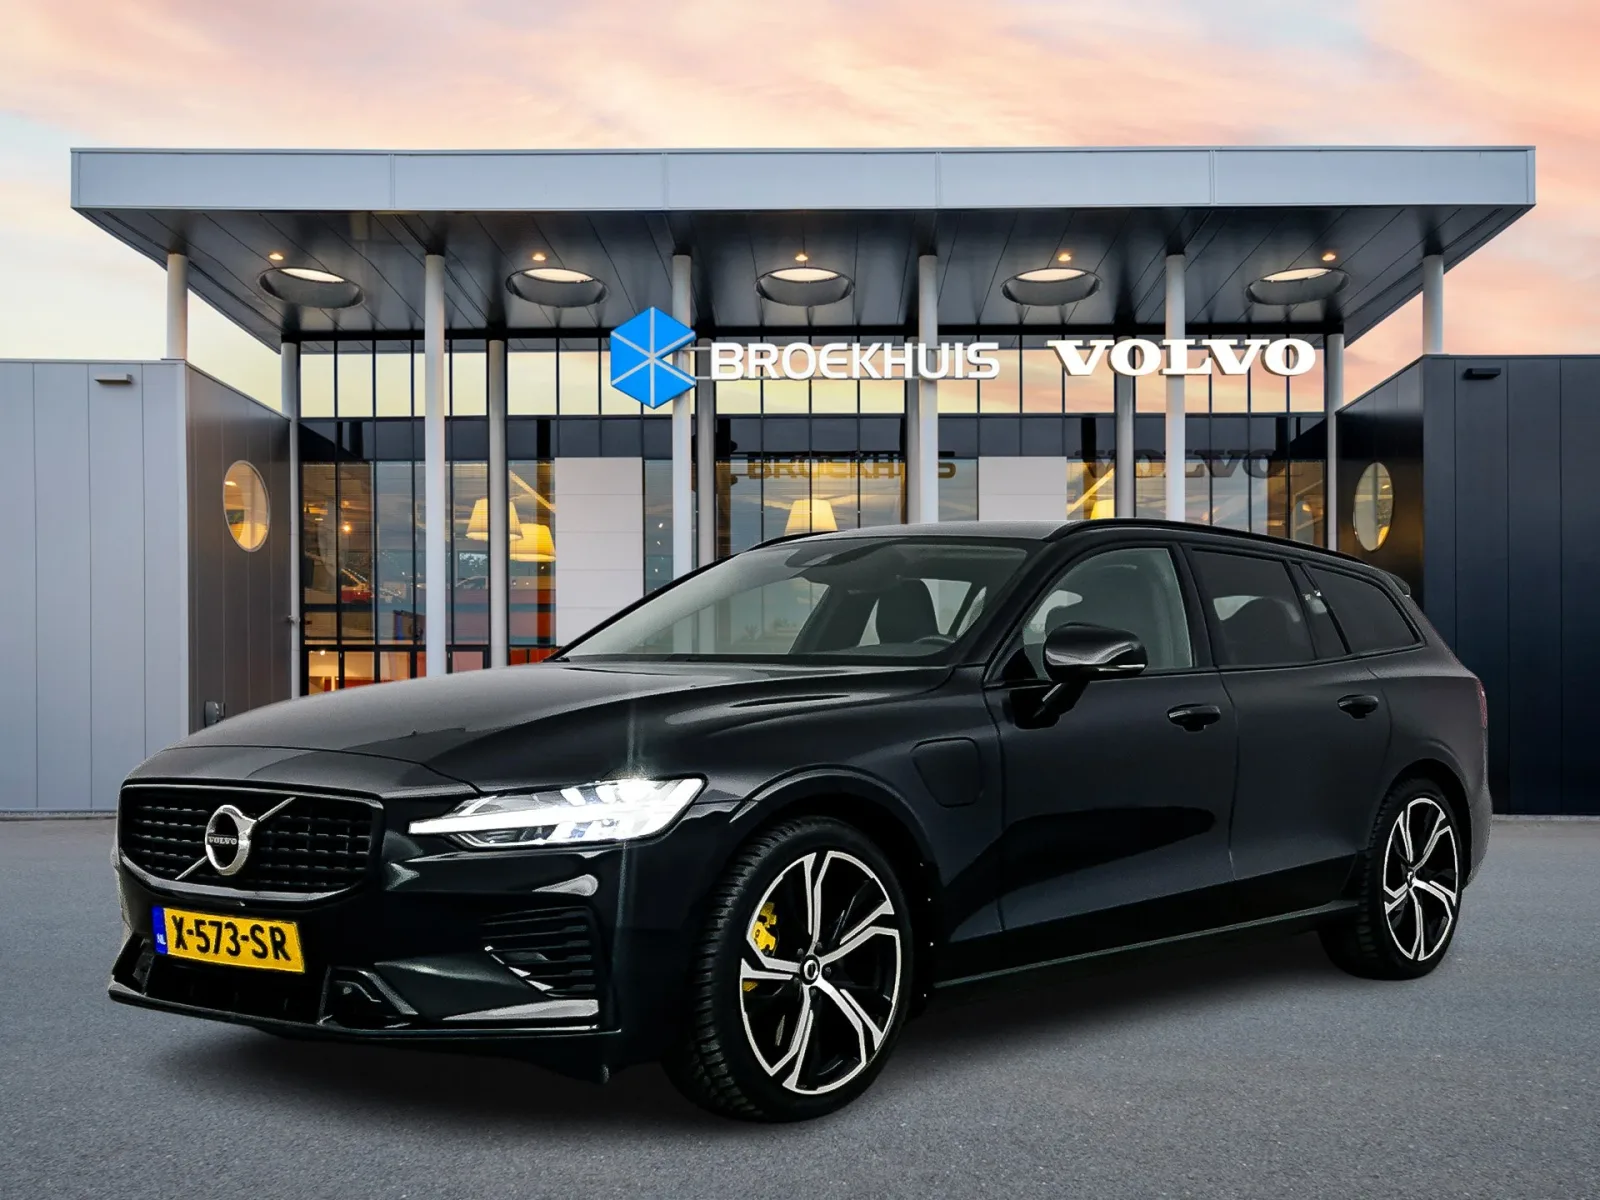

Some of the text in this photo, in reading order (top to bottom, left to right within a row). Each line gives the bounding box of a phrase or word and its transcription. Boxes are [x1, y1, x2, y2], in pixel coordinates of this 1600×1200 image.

[711, 342, 1000, 380] BROEKHUIS
[1047, 338, 1316, 376] VOLVO
[208, 836, 238, 845] VOLVO
[171, 914, 292, 962] X-573-SR
